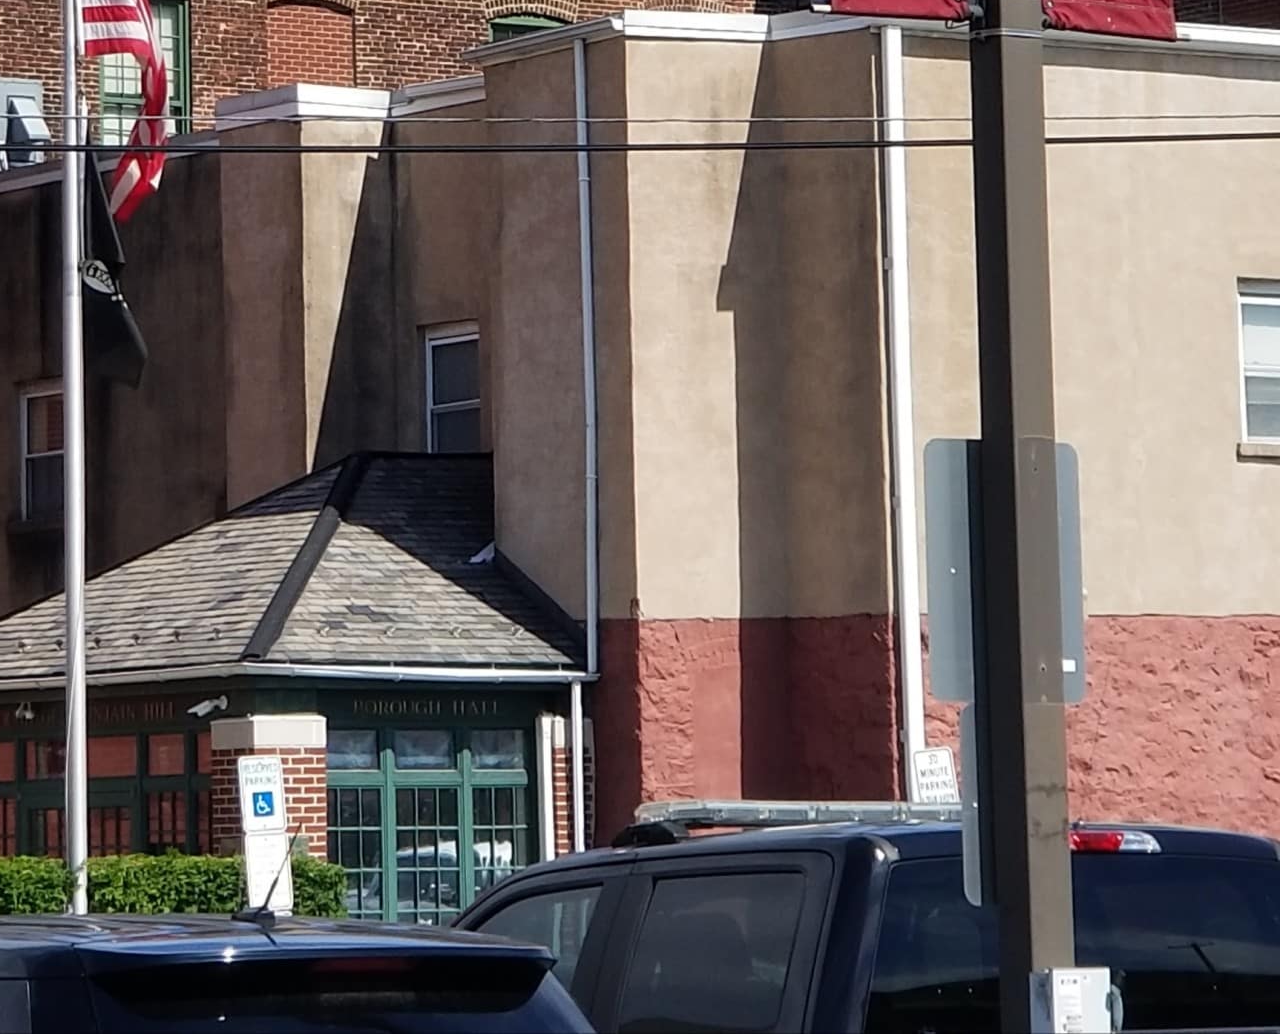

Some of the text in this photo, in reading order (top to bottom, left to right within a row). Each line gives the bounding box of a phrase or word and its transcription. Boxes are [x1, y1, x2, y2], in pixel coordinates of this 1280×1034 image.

[353, 699, 500, 716] BOROUGH HALL
[920, 766, 950, 778] MINUTE
[244, 774, 278, 787] PARKING
[920, 779, 953, 790] PARKING
